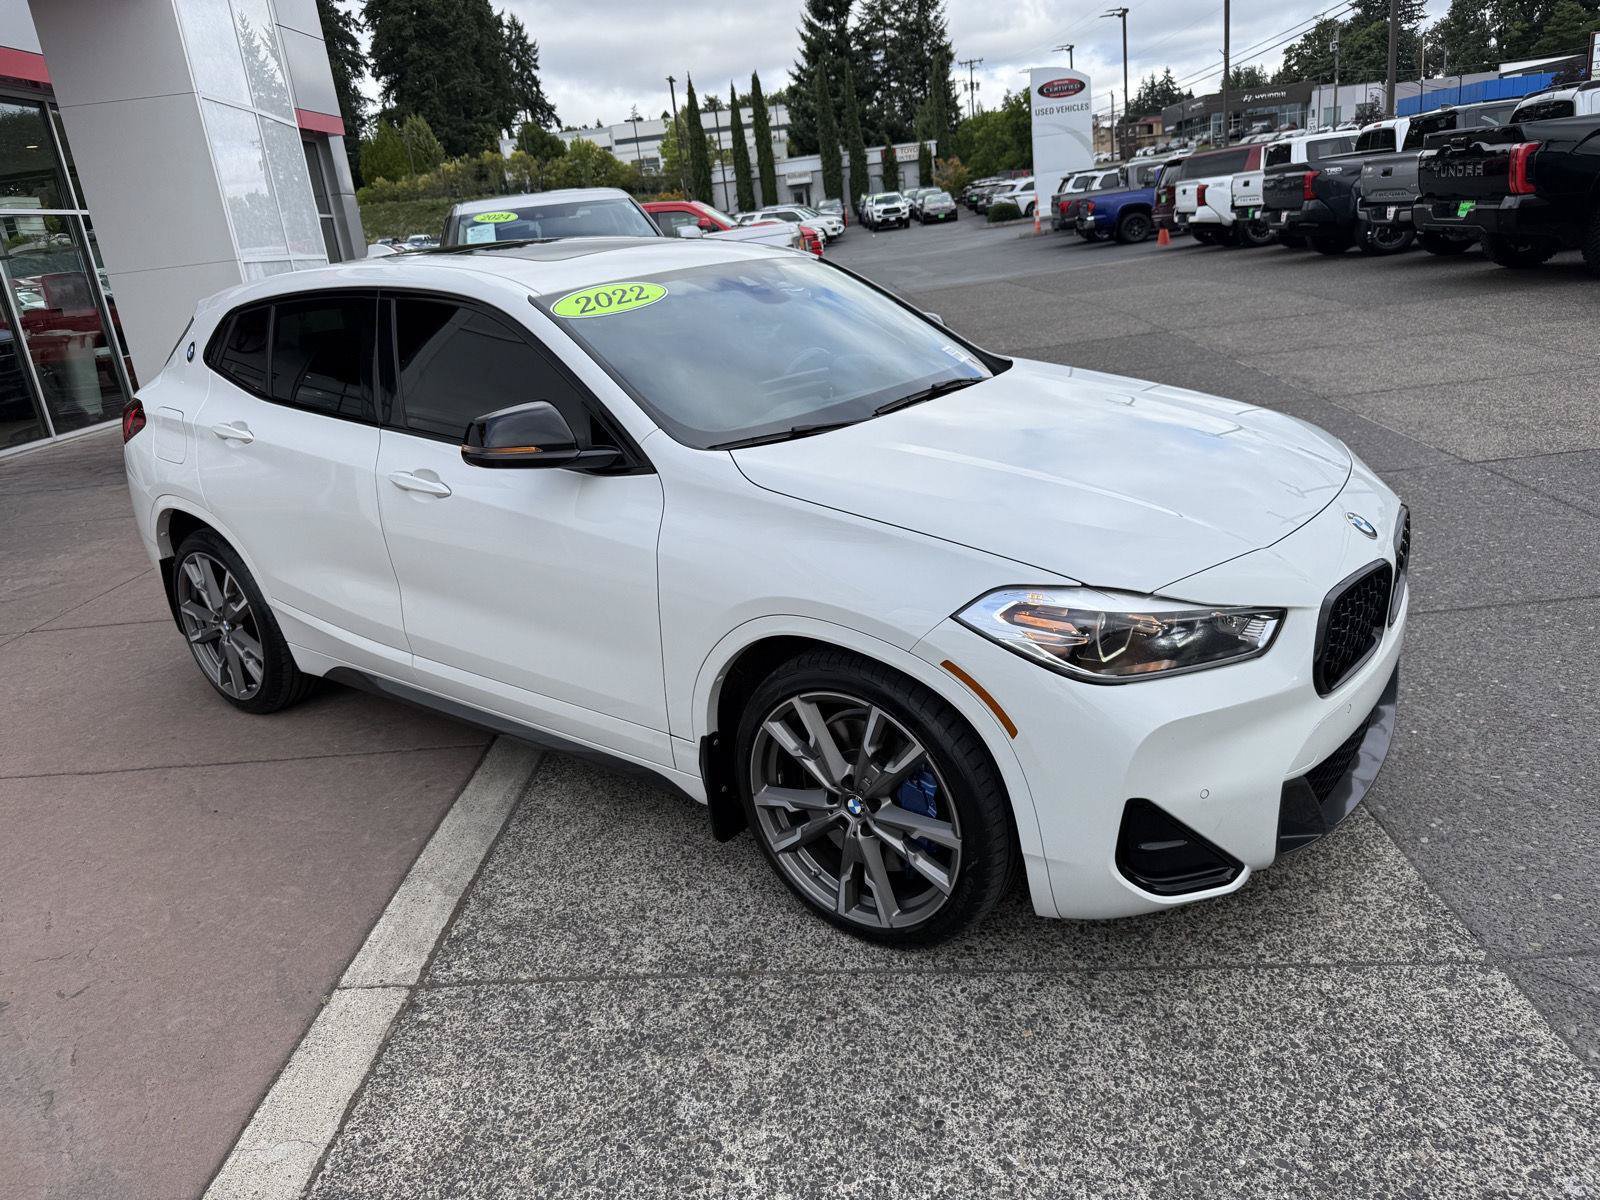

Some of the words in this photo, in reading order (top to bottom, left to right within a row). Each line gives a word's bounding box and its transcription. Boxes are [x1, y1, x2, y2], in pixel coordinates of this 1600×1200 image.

[1035, 107, 1054, 116] USED
[1055, 102, 1089, 114] VEHICLES
[1433, 164, 1484, 178] TUNDRA
[480, 213, 512, 221] 2024
[575, 285, 650, 314] 2022
